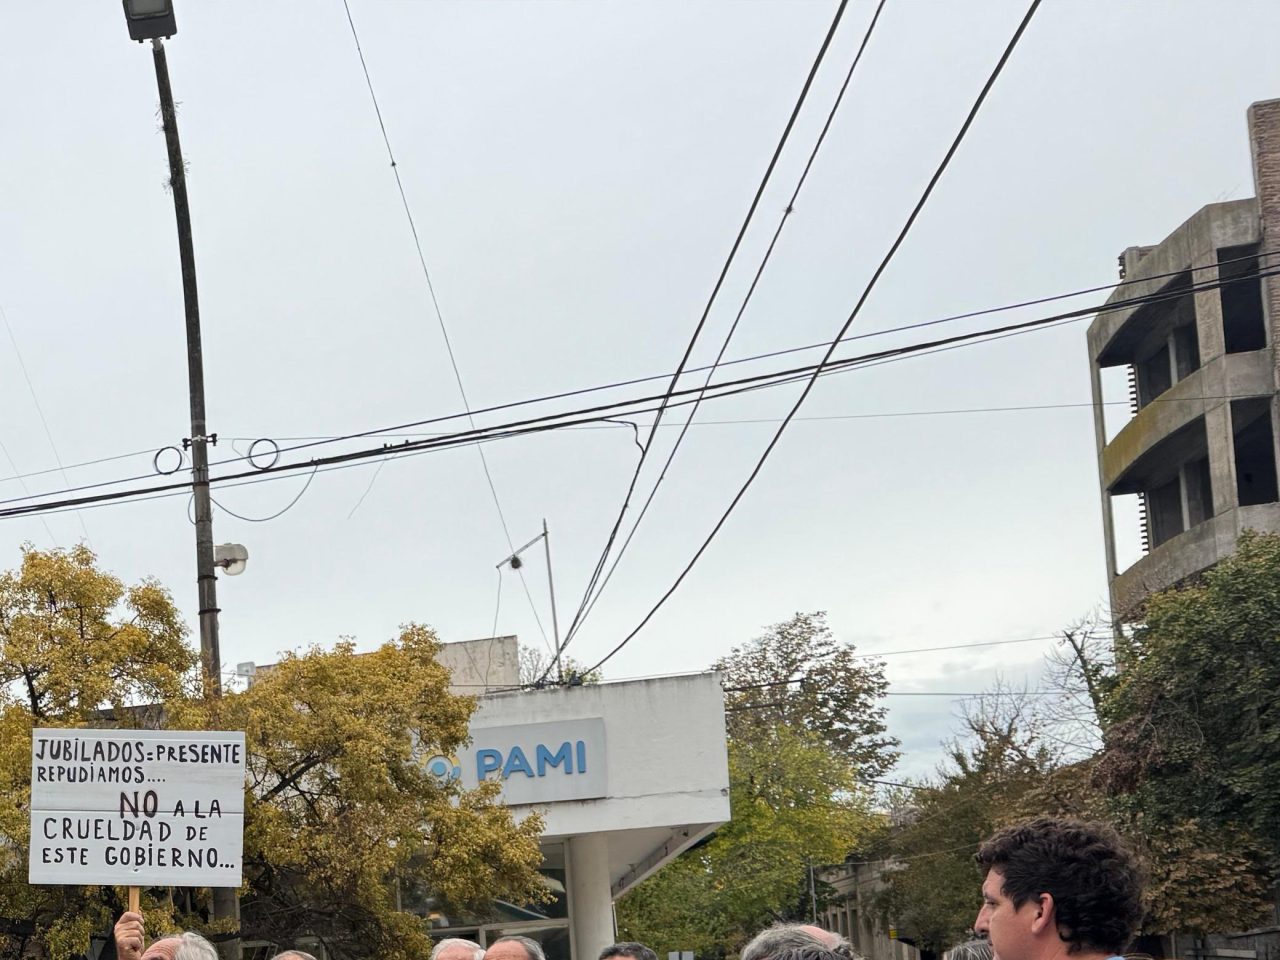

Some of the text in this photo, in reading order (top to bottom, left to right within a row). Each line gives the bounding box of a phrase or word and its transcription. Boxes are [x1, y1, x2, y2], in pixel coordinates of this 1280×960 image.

[476, 740, 587, 781] PAMI
[120, 789, 222, 819] NO A LA
[44, 817, 208, 842] CRUELDAD DE
[42, 847, 89, 865] ESTE
